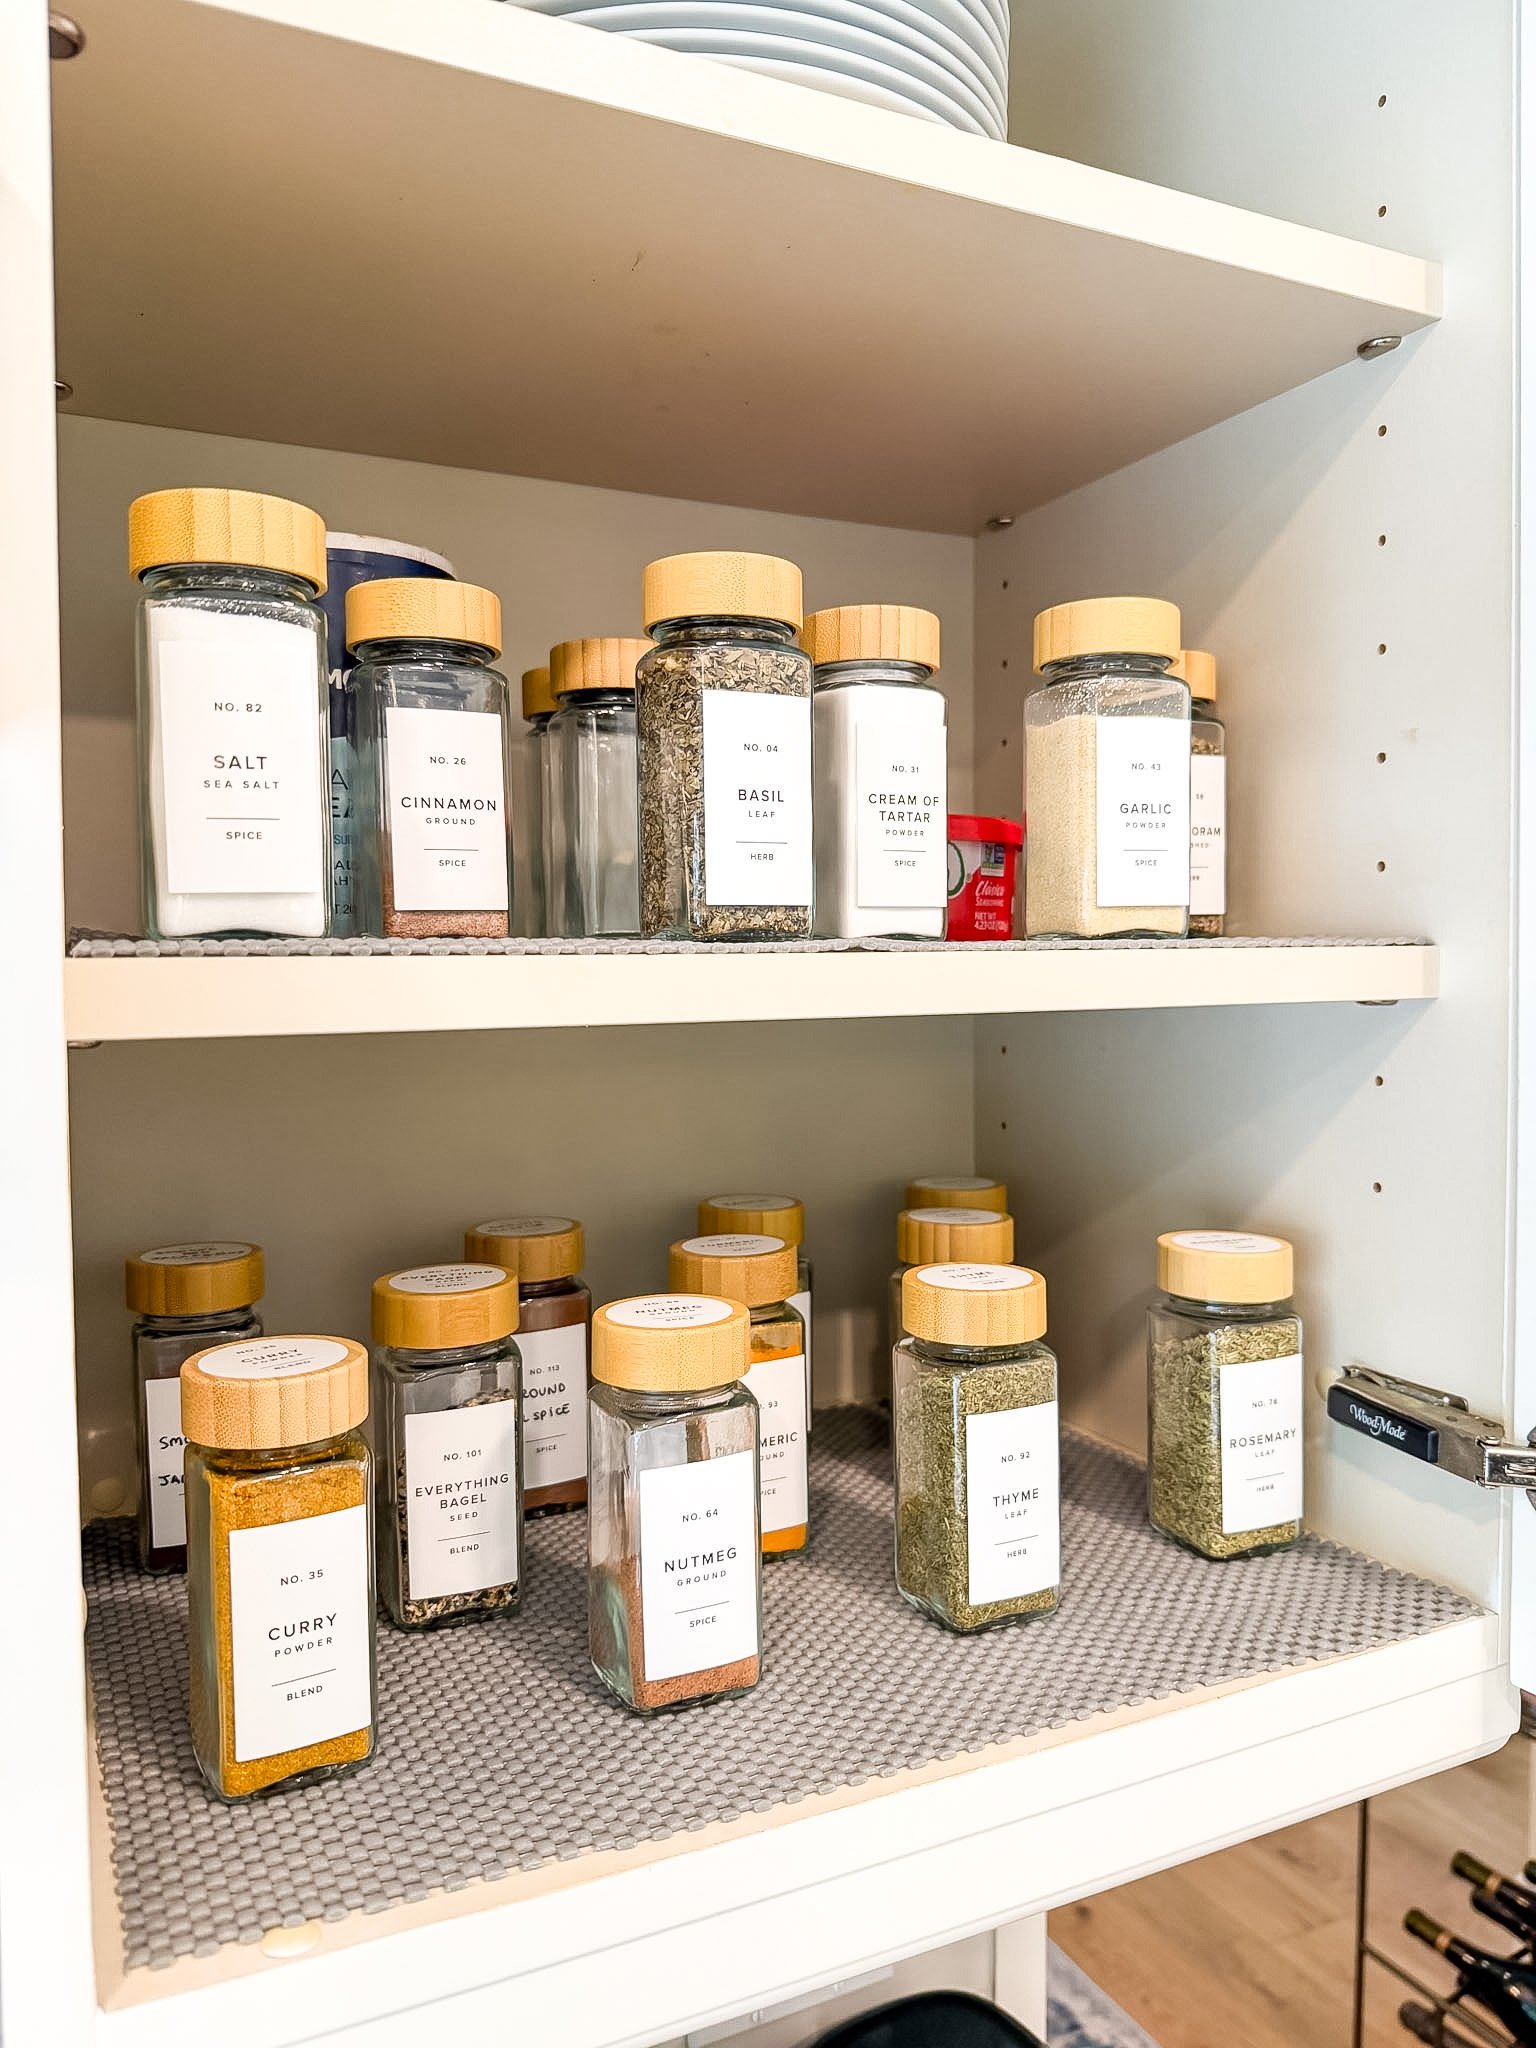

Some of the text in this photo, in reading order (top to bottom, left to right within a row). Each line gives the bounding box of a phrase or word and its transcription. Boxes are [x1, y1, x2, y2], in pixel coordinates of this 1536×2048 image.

[214, 702, 262, 713] NO. 82
[743, 743, 779, 753] NO. 04
[213, 755, 268, 770] SALT
[429, 756, 467, 766] NO. 26
[1131, 762, 1161, 771] NO. 43
[892, 764, 919, 774] NO. 31
[203, 779, 280, 790] SEA SALT
[738, 788, 785, 803] BASIL
[868, 793, 940, 807] CREAM OF
[401, 796, 497, 812] CINNAMON
[1119, 803, 1172, 815] GARLIC
[748, 810, 776, 818] LEAF
[879, 810, 931, 823] TARTAR
[425, 817, 476, 826] GROUND
[226, 831, 263, 840] SPICE
[885, 829, 925, 837] POWDER
[1191, 826, 1221, 837] ORAM
[438, 859, 467, 867] SPICE
[750, 853, 774, 861] HERB
[894, 859, 916, 867] SPICE
[1135, 859, 1158, 867] SPICE
[522, 1382, 567, 1399] ROUND
[760, 1431, 798, 1448] MERIC
[1229, 1427, 1297, 1449] ROSEMARY
[536, 1444, 558, 1454] SPICE
[1254, 1448, 1276, 1458] LEAF
[443, 1449, 482, 1462] NO. 101
[760, 1451, 785, 1462] OUND
[1001, 1451, 1031, 1463] NO. 92
[415, 1473, 510, 1498] EVERYTHING
[440, 1492, 488, 1510] BAGEL
[992, 1487, 1039, 1508] THYME
[449, 1511, 479, 1522] SEED
[682, 1508, 719, 1523] NO. 64
[1004, 1508, 1028, 1520] LEAF
[449, 1543, 480, 1555] BLEND
[1007, 1547, 1028, 1559] HERB
[664, 1547, 737, 1574] NUTMEG
[280, 1569, 324, 1586] NO. 35
[676, 1569, 728, 1587] GROUND
[268, 1612, 337, 1641] CURRY
[689, 1615, 717, 1628] SPICE
[274, 1636, 333, 1658] POWDER
[286, 1685, 323, 1702] BLEND
